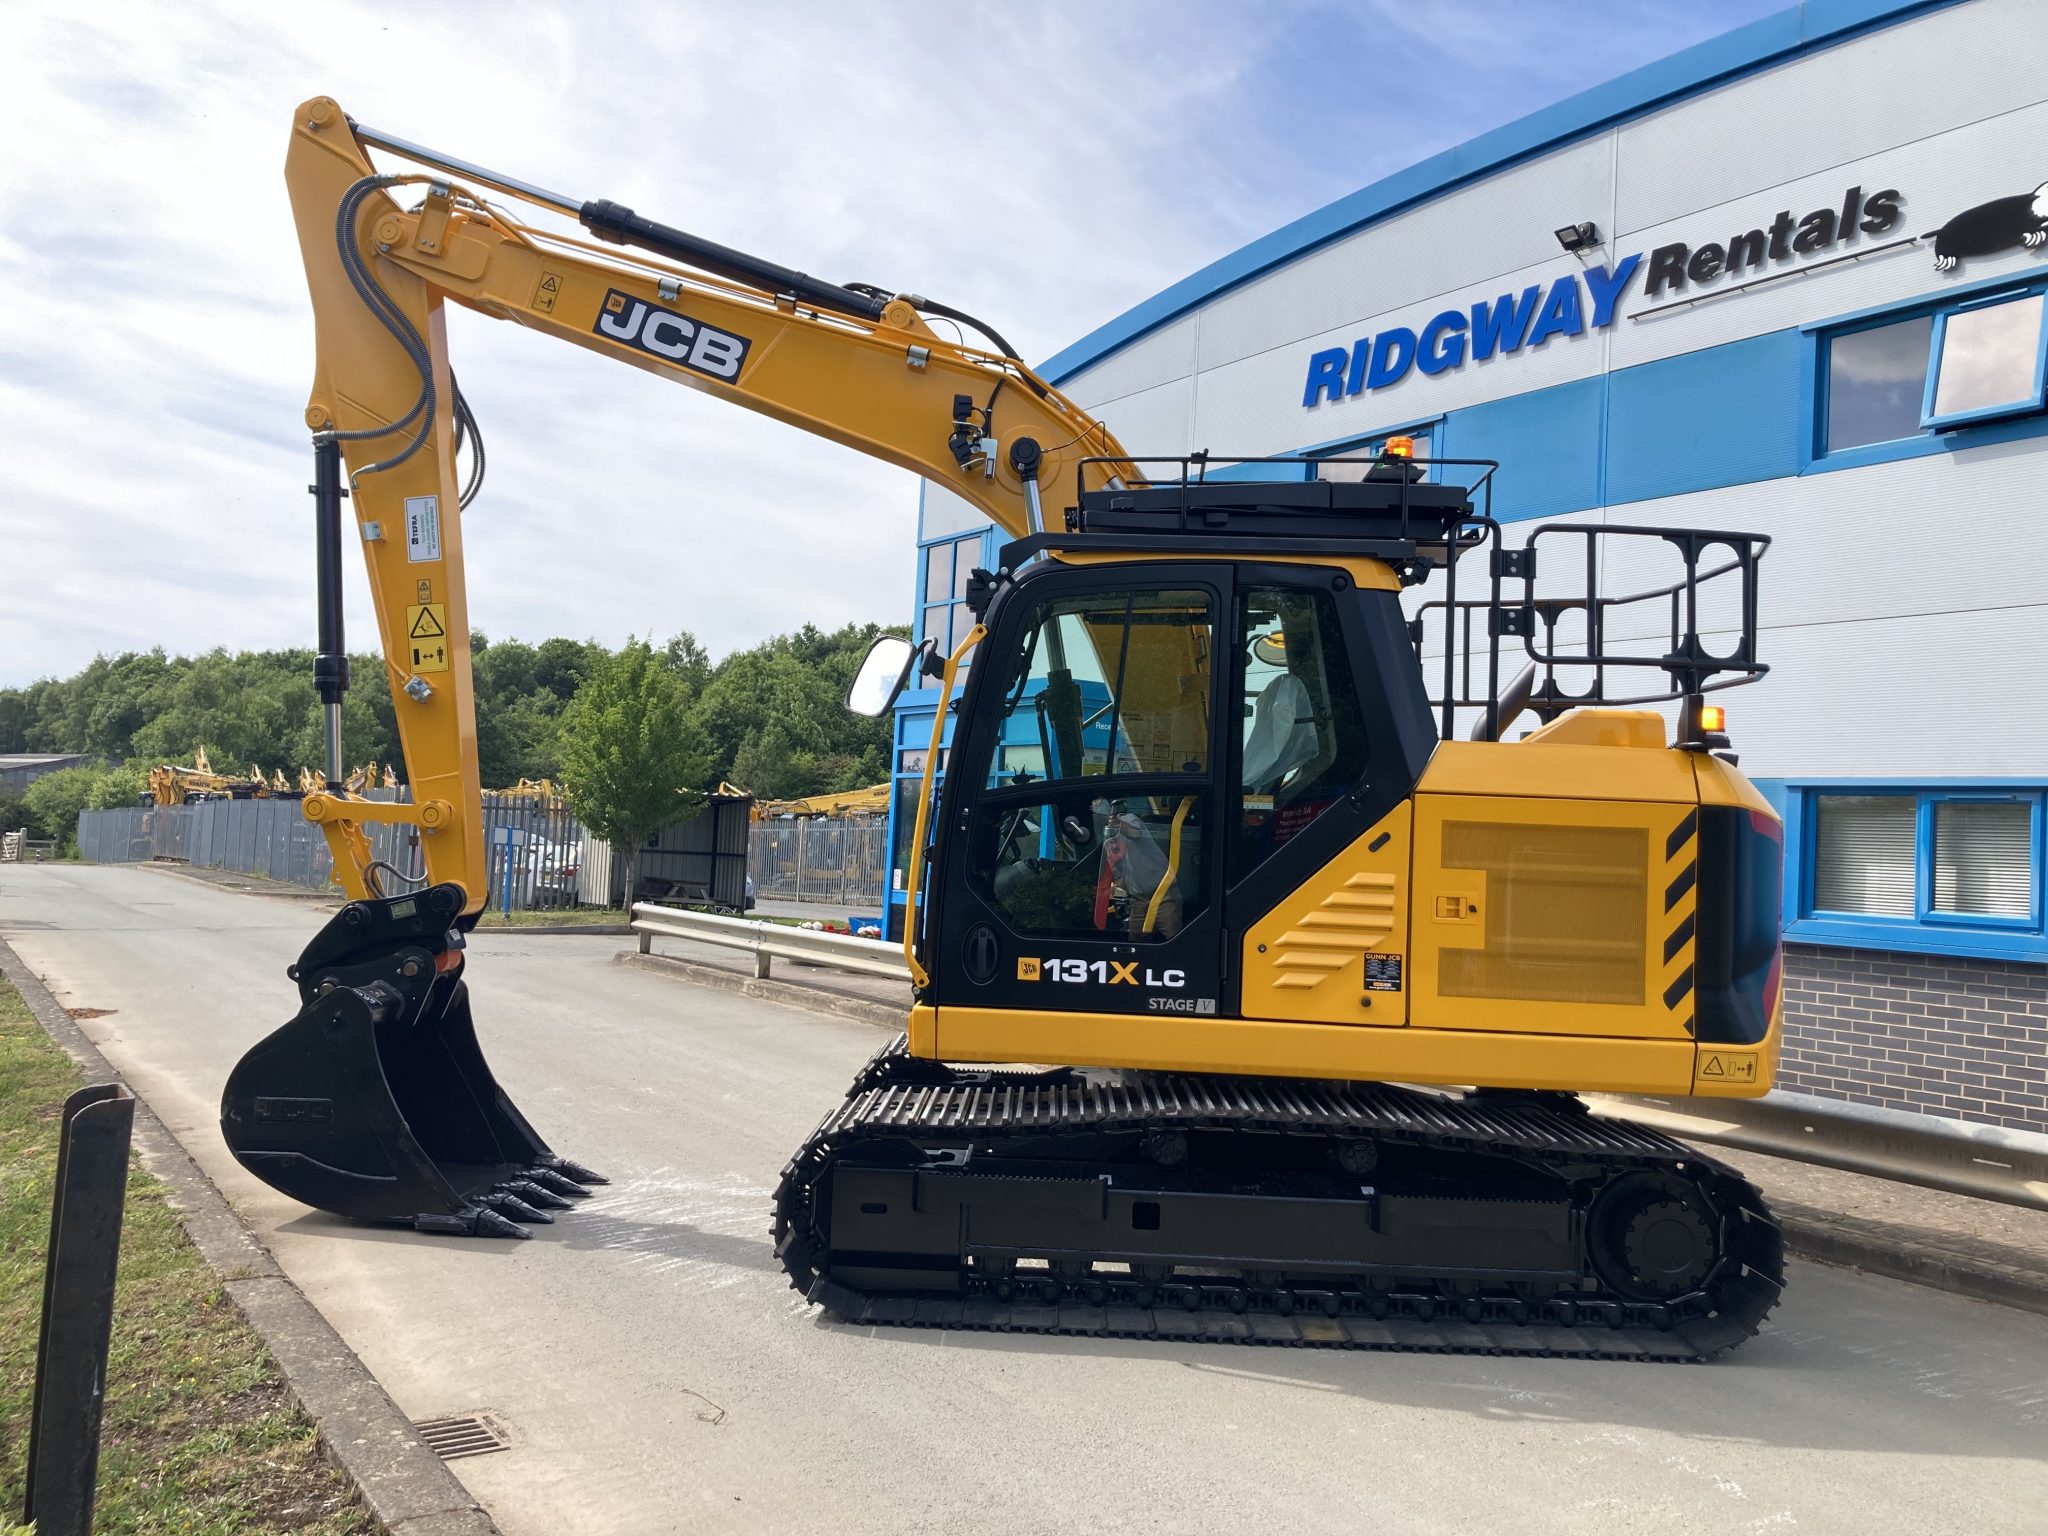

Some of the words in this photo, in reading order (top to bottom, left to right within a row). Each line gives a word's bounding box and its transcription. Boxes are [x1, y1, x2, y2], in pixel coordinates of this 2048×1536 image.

[1302, 252, 1644, 408] RIDGWAY
[1644, 185, 1900, 296] Rentals
[600, 302, 744, 377] JCB
[1043, 958, 1139, 985] 131X
[1145, 969, 1185, 987] LC
[1149, 997, 1194, 1011] STAGE
